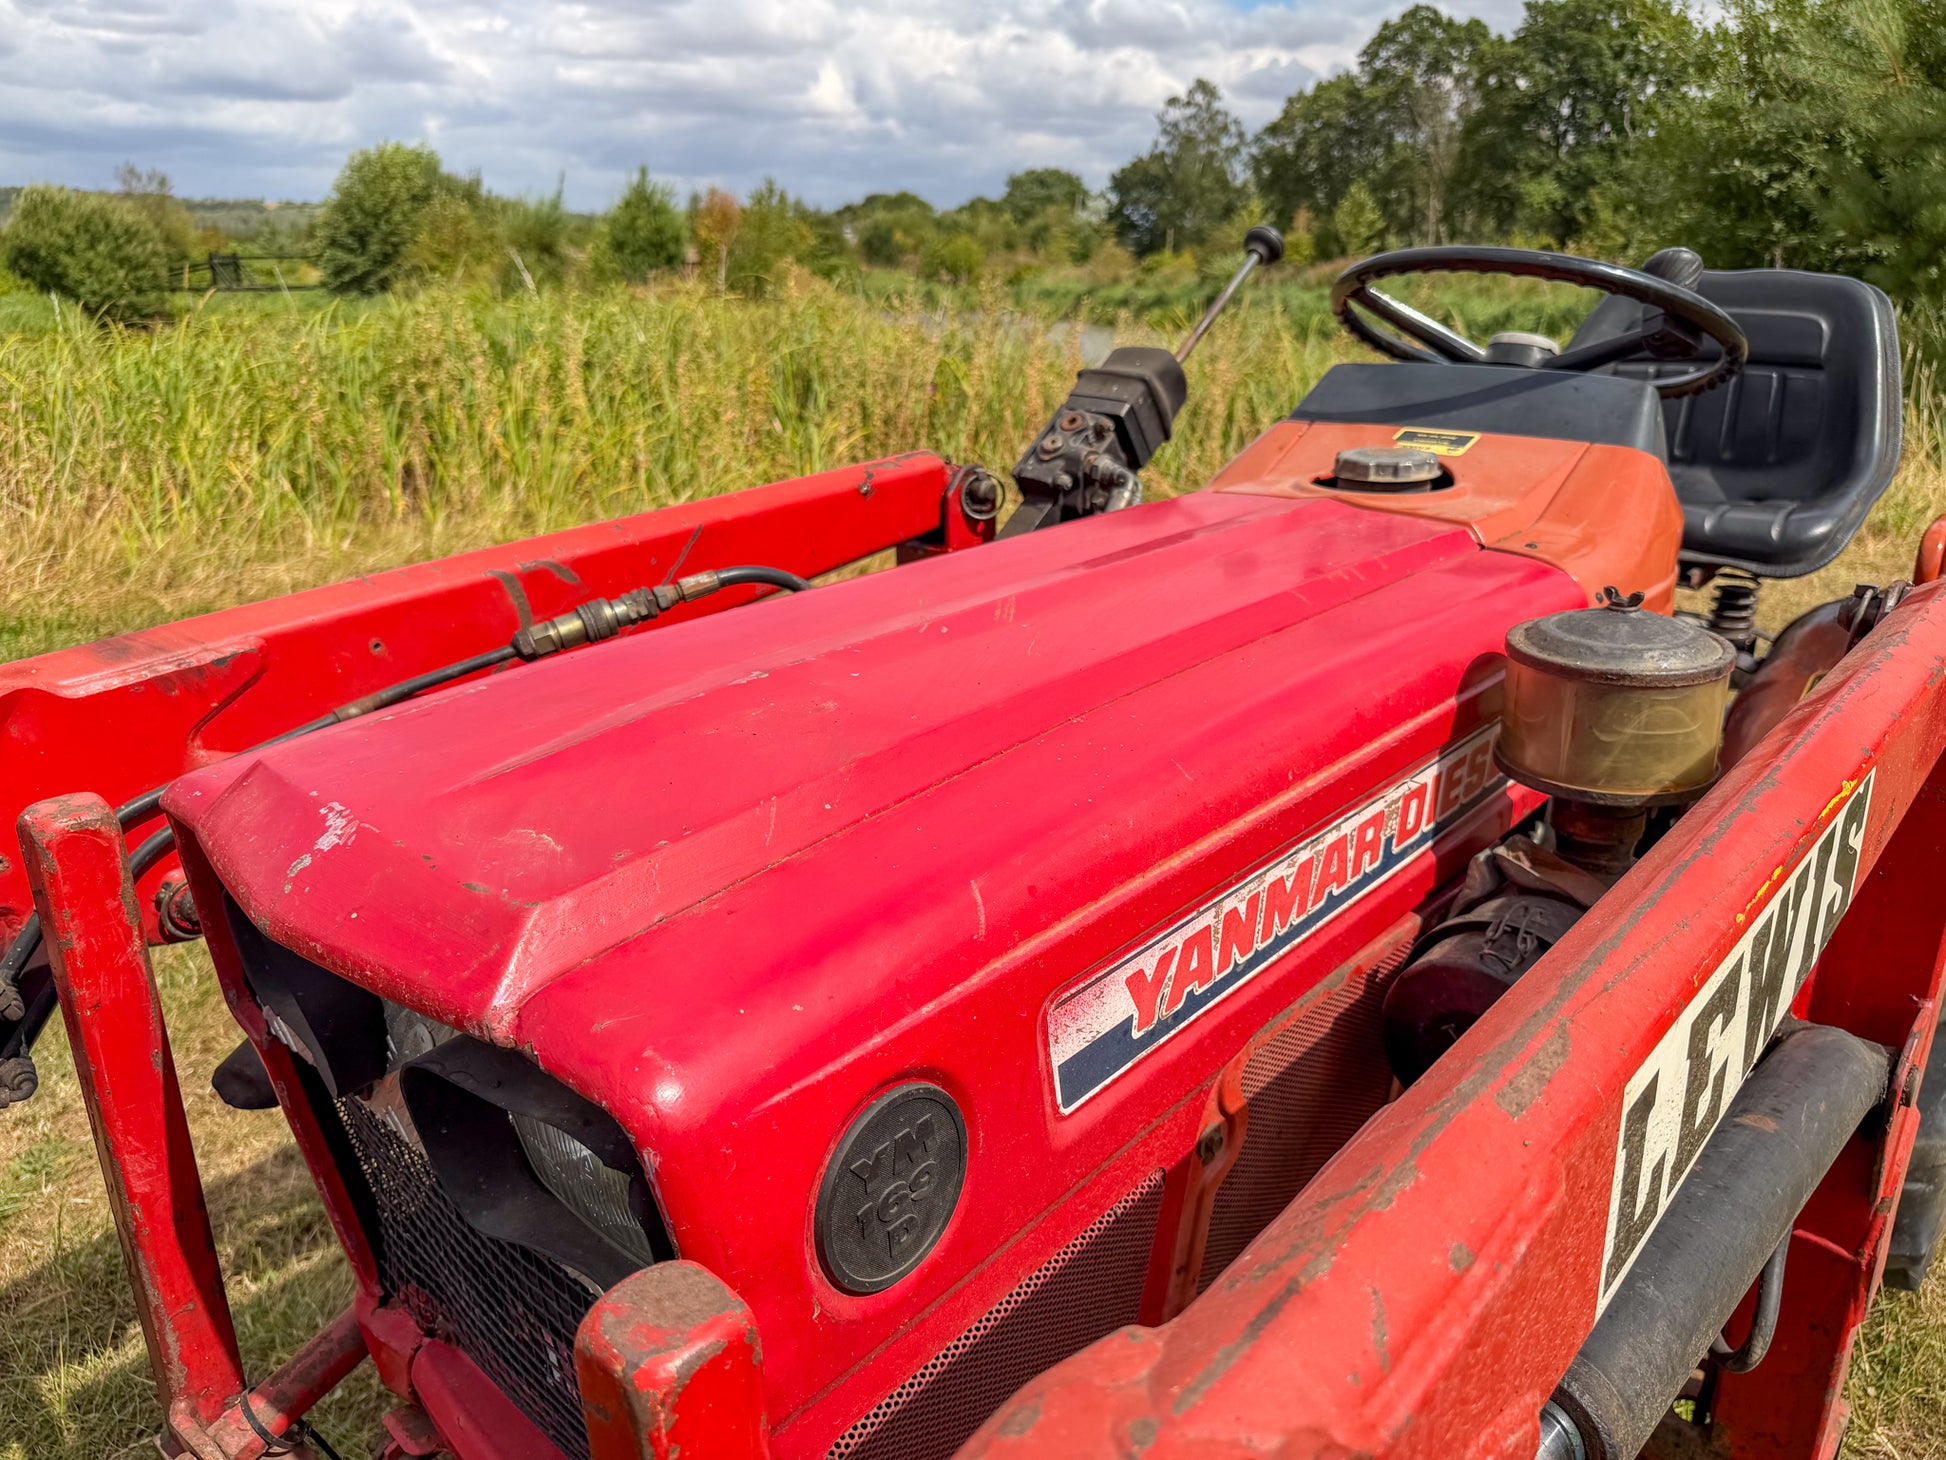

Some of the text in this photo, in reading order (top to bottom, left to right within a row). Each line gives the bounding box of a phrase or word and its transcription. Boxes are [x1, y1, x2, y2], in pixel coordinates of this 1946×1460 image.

[1124, 809, 1386, 1034] YANMAR
[1602, 774, 1873, 1298] LEWIS
[850, 1113, 938, 1195] YM
[856, 1160, 938, 1241] 169
[887, 1213, 921, 1258] D
